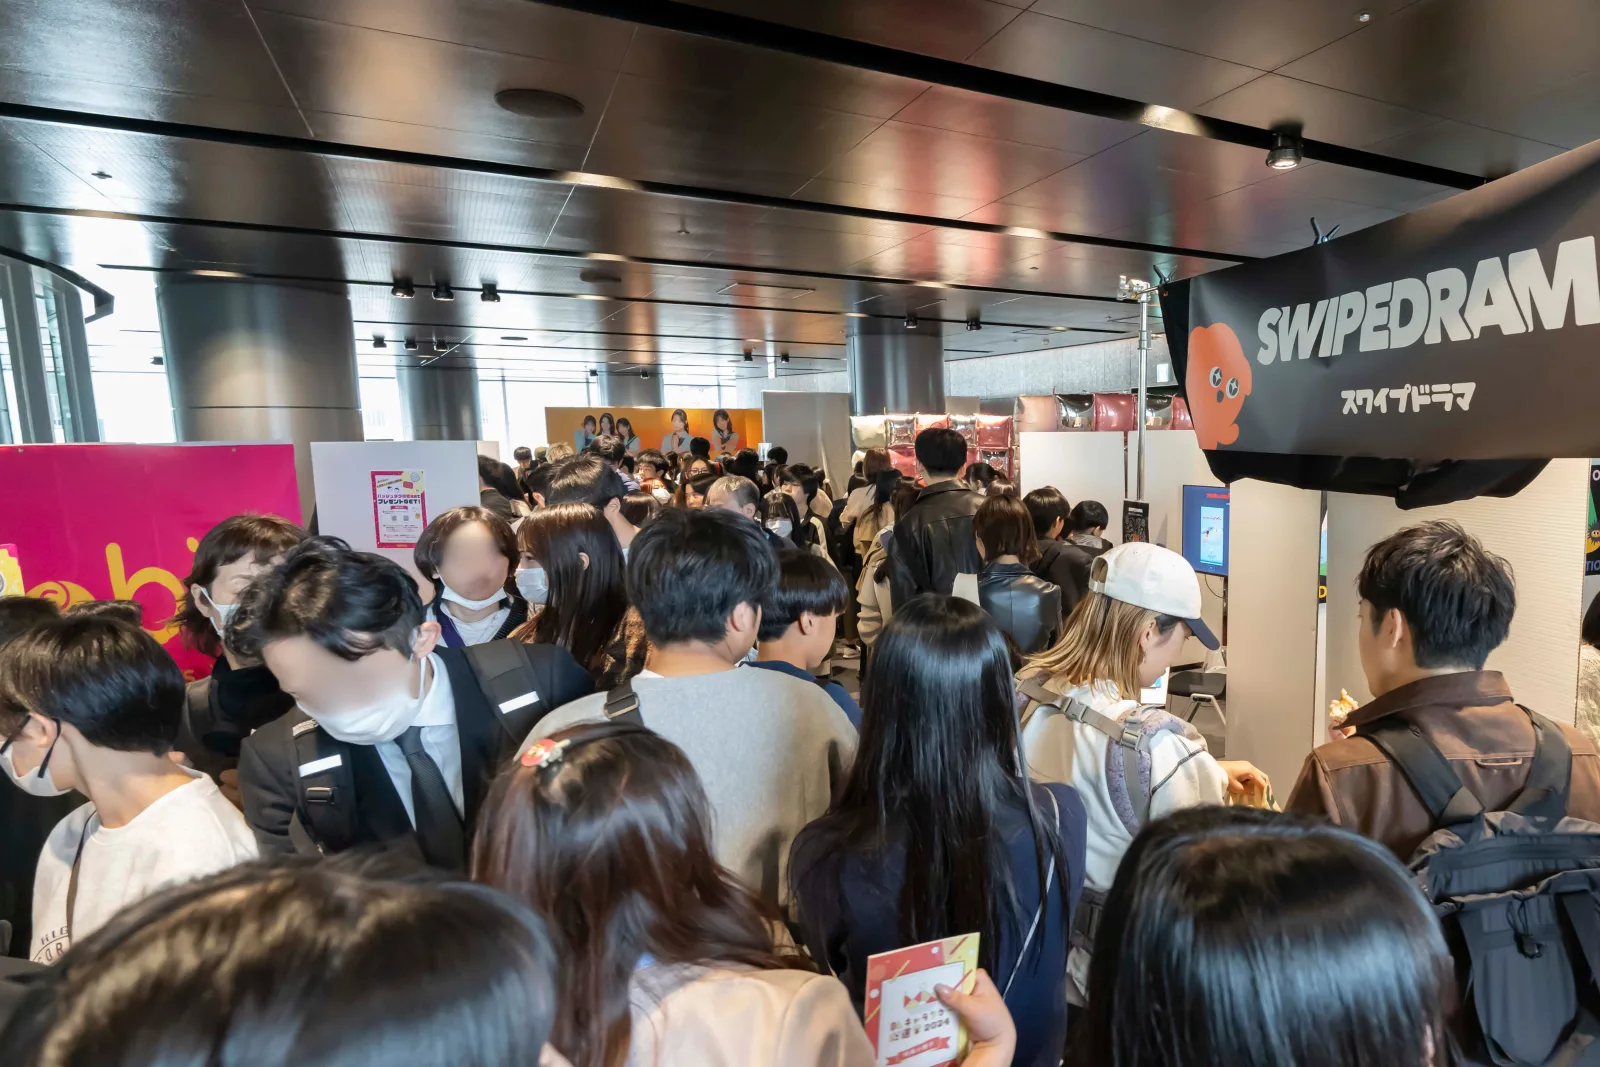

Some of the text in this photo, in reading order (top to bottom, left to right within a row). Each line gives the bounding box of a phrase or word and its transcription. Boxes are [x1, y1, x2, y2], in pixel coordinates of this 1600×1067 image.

[1257, 235, 1600, 366] SWIPEDRAM
[1341, 382, 1476, 415] スワイプドラマ
